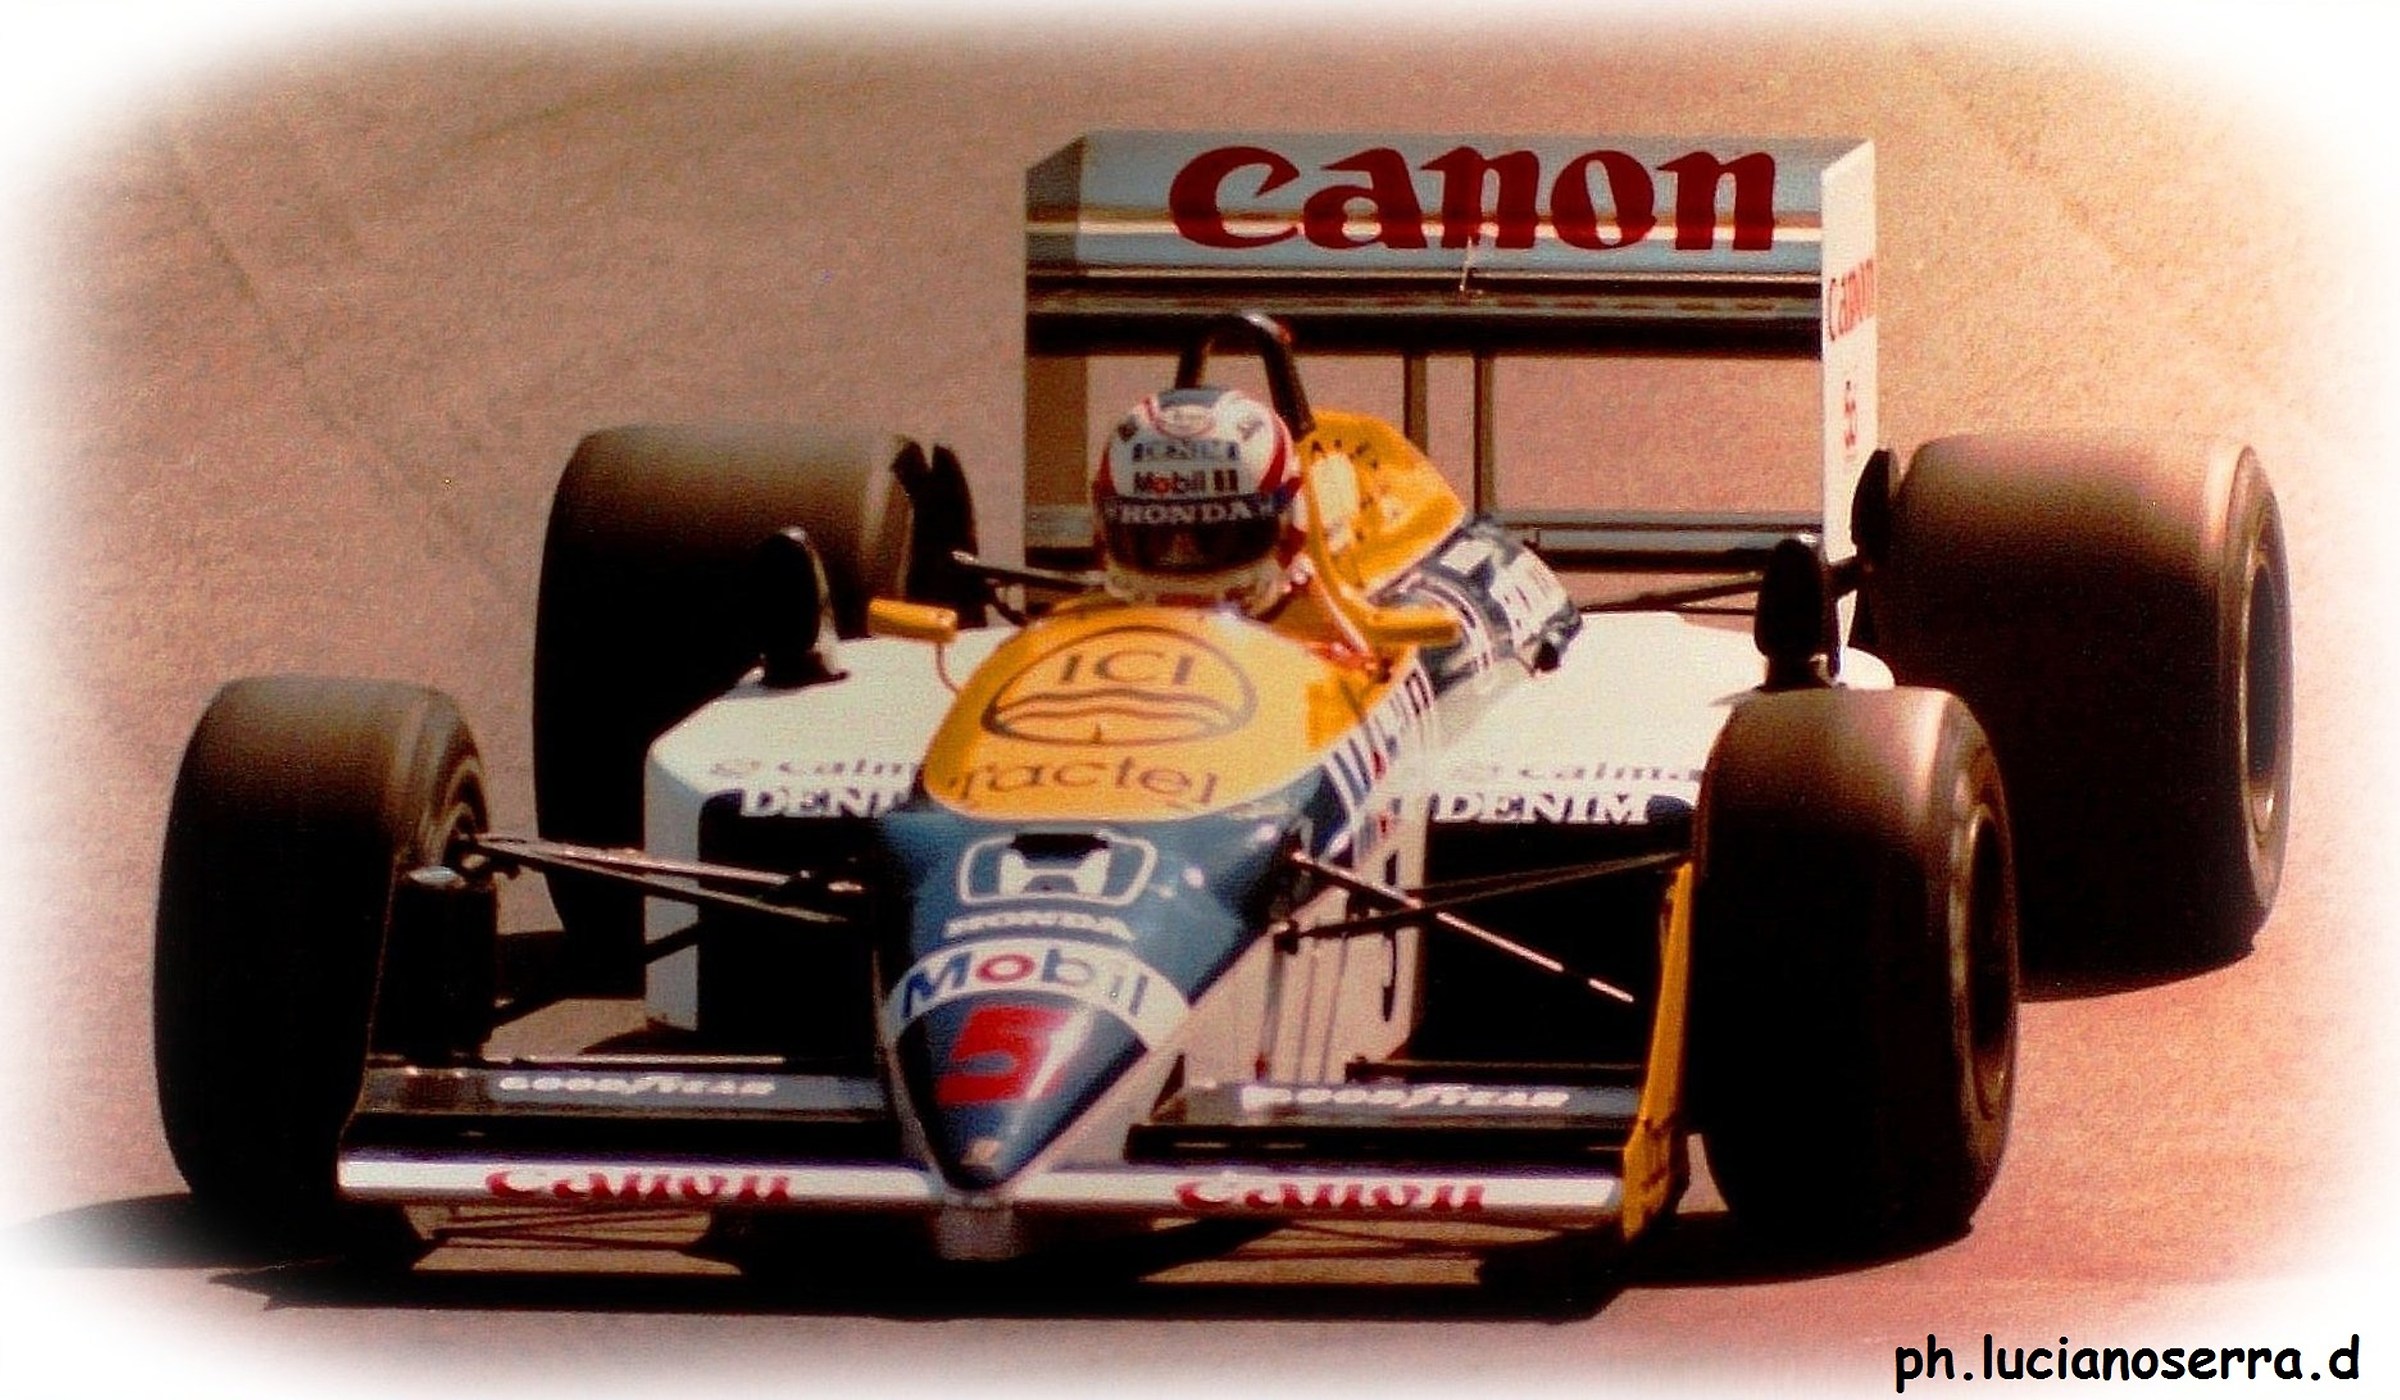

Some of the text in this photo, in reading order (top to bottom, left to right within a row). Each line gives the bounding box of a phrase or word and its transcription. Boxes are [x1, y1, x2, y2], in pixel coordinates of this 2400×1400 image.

[1168, 146, 1776, 251] Canon
[1828, 259, 1874, 341] Canon
[1133, 470, 1206, 494] Mobil
[1120, 502, 1253, 524] HONDA
[1059, 652, 1196, 686] ICI
[1434, 793, 1650, 823] DENIM
[942, 910, 1137, 943] HONDA
[902, 947, 1150, 1019] Mobil
[935, 1002, 1077, 1110] 5
[499, 1075, 777, 1095] GOODYEAR
